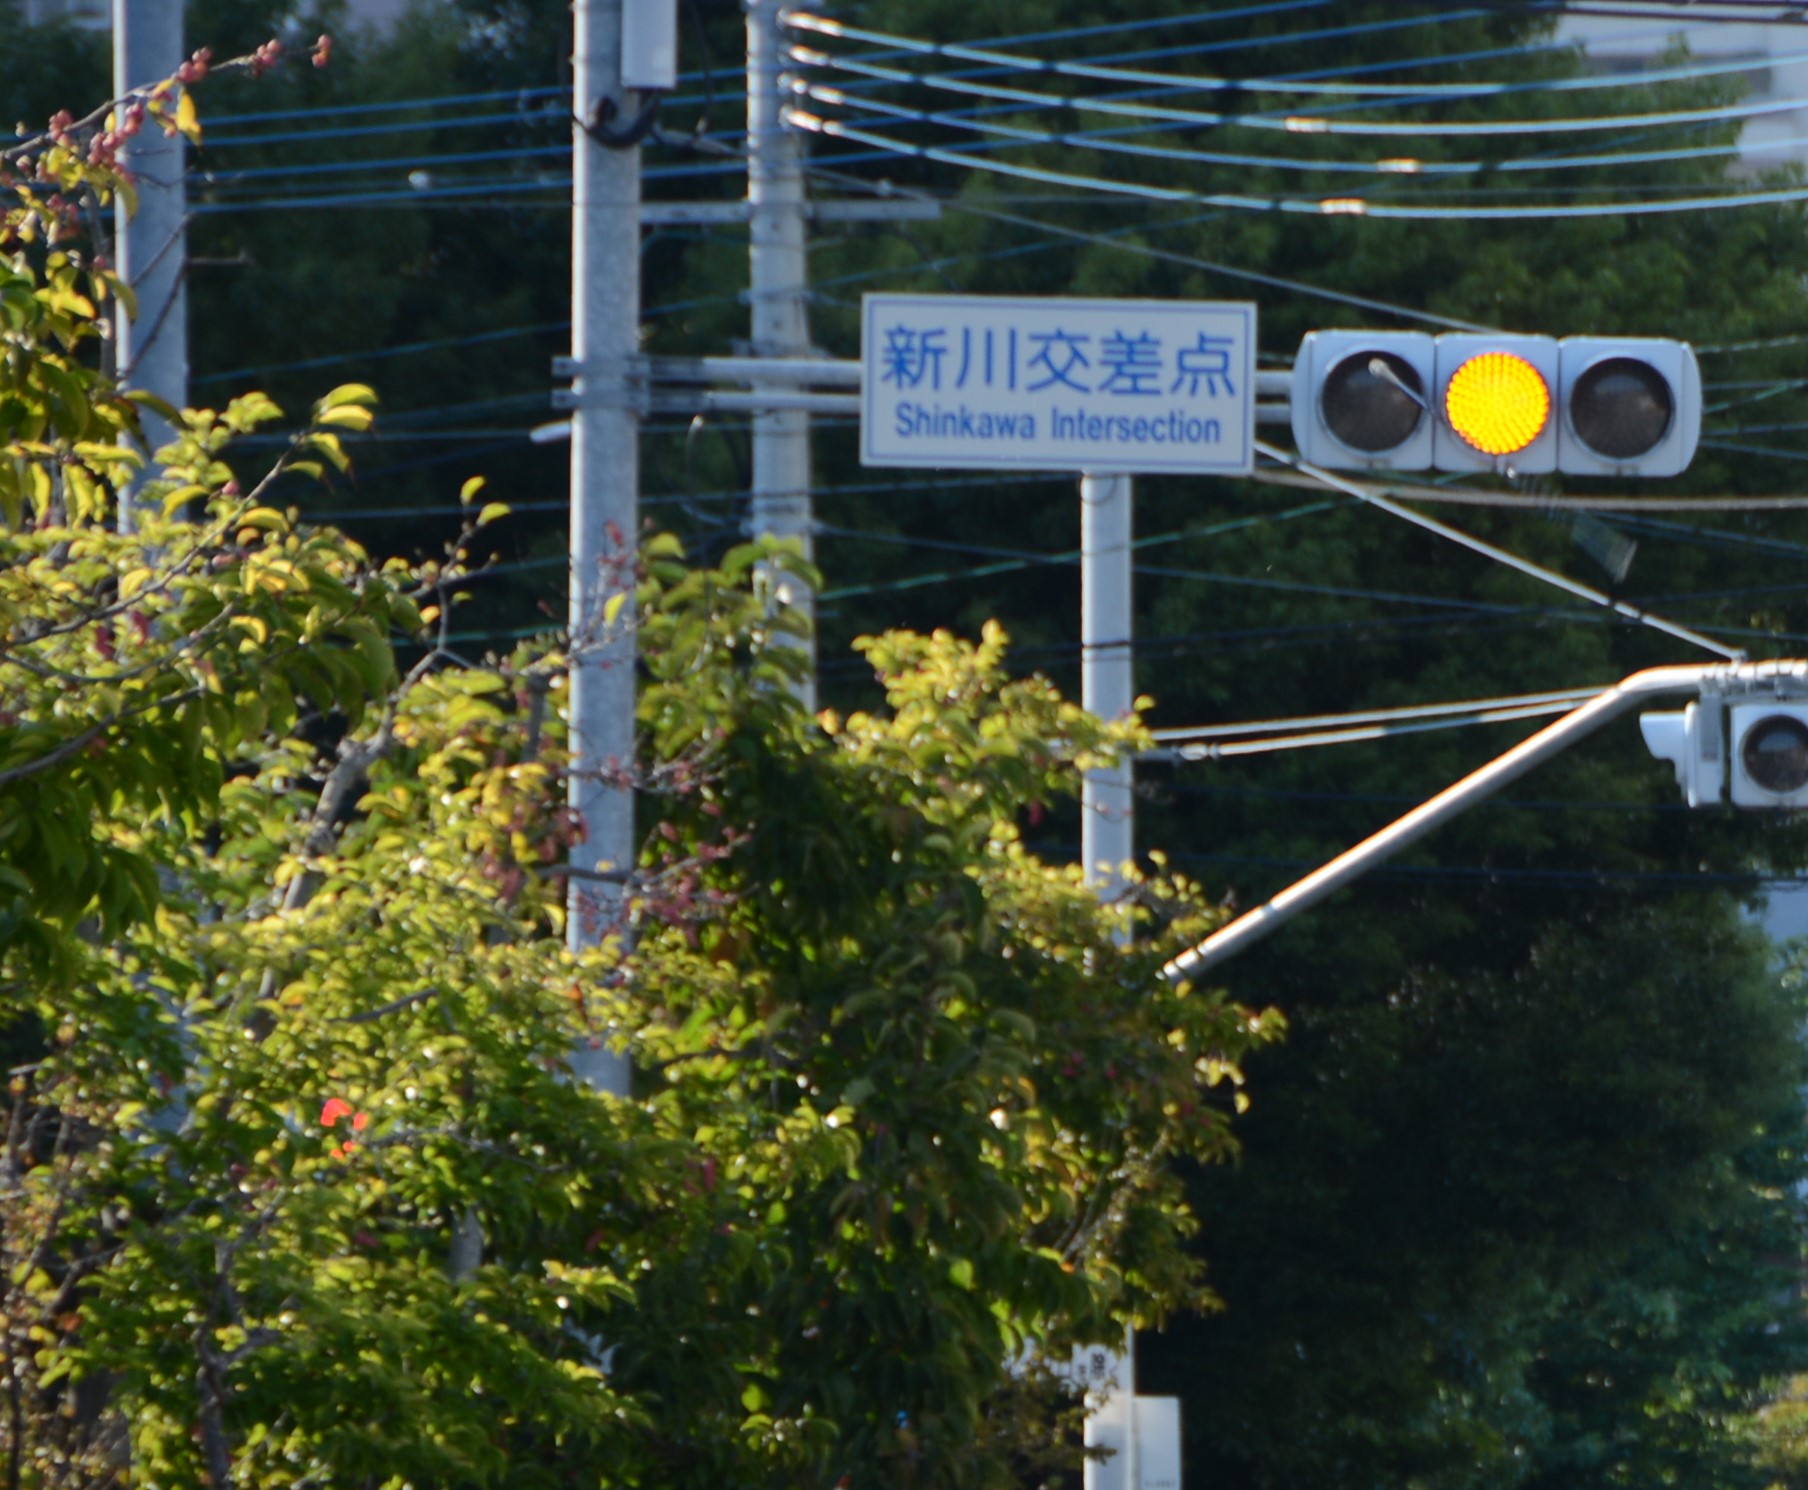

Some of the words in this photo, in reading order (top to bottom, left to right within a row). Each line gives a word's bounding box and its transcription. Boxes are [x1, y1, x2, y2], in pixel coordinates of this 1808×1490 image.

[881, 325, 1235, 398] 新川交差点
[895, 403, 1035, 439] Shinkawa
[1051, 408, 1222, 443] Intersection
